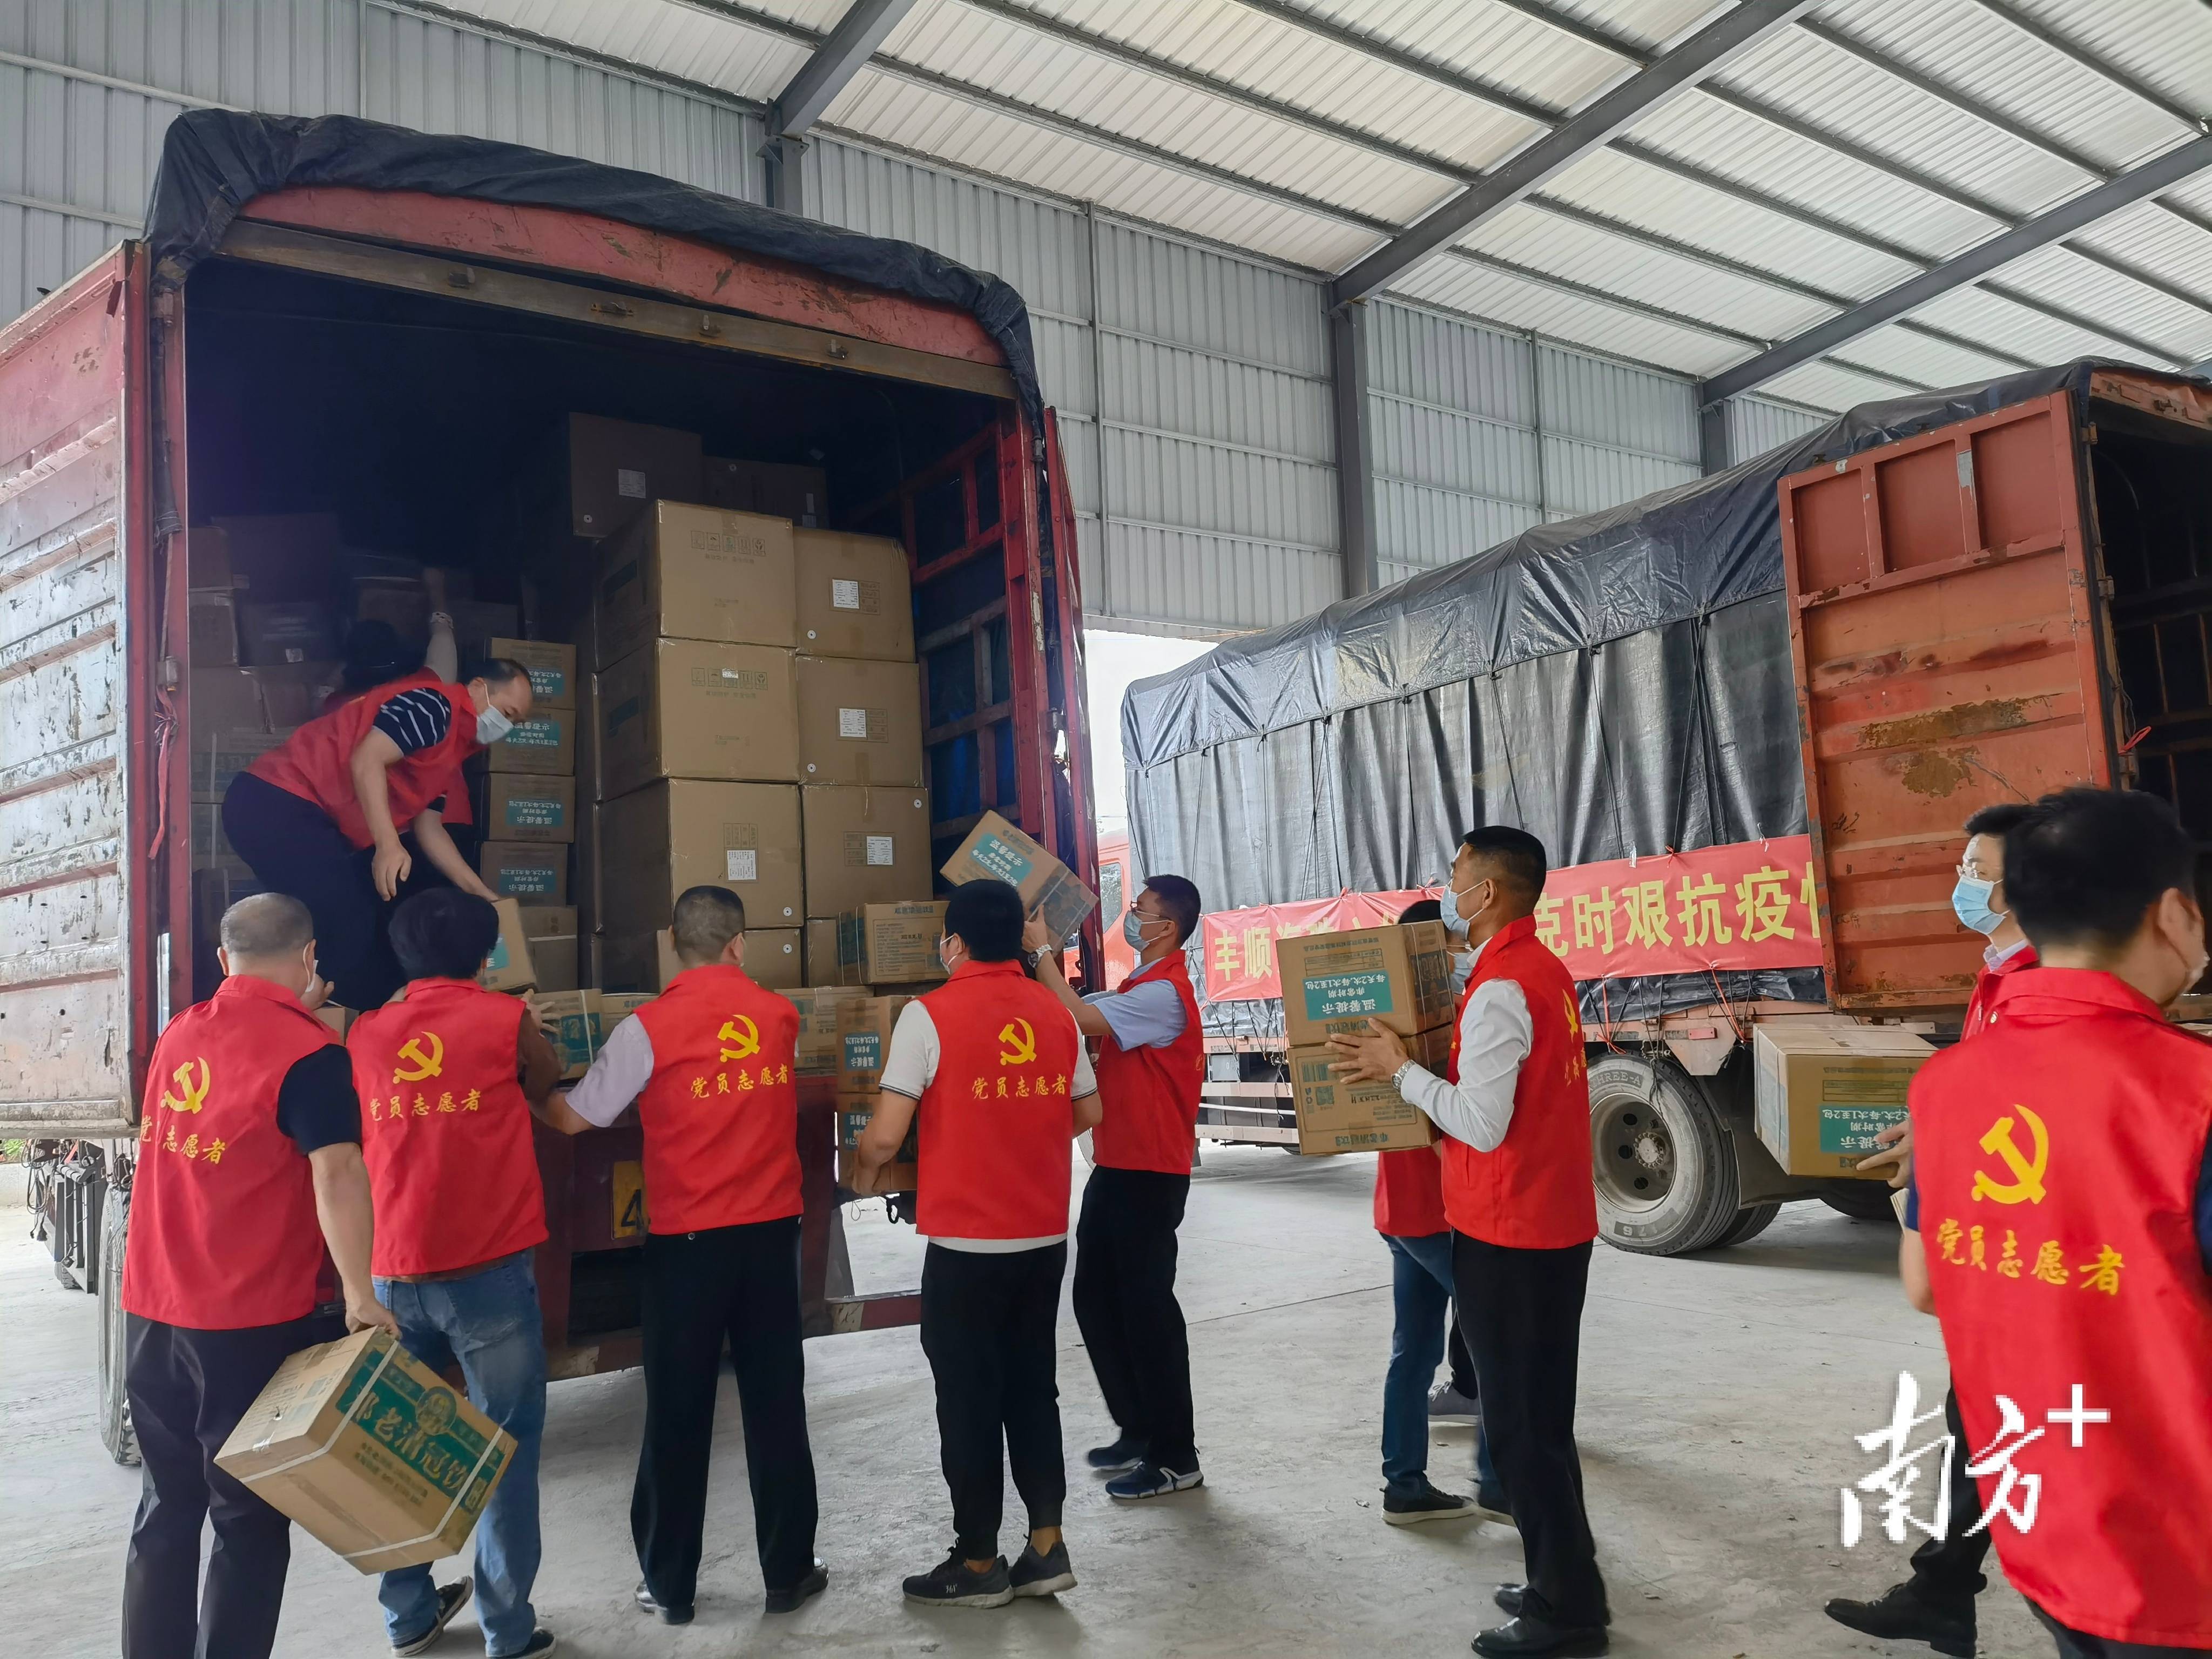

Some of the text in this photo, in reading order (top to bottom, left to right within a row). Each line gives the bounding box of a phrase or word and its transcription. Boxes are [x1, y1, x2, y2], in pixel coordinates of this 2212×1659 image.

[1322, 999, 1377, 1014] 温馨提示
[1328, 986, 1365, 999] 非常时期
[690, 1063, 789, 1100] 党员志愿者
[972, 1074, 1067, 1100] 党员志愿者
[1589, 1071, 1641, 1089] THREE-A
[370, 1088, 482, 1123] 党员志愿者
[139, 1114, 226, 1165] 党志愿者
[1936, 1217, 2126, 1296] 党员志愿者
